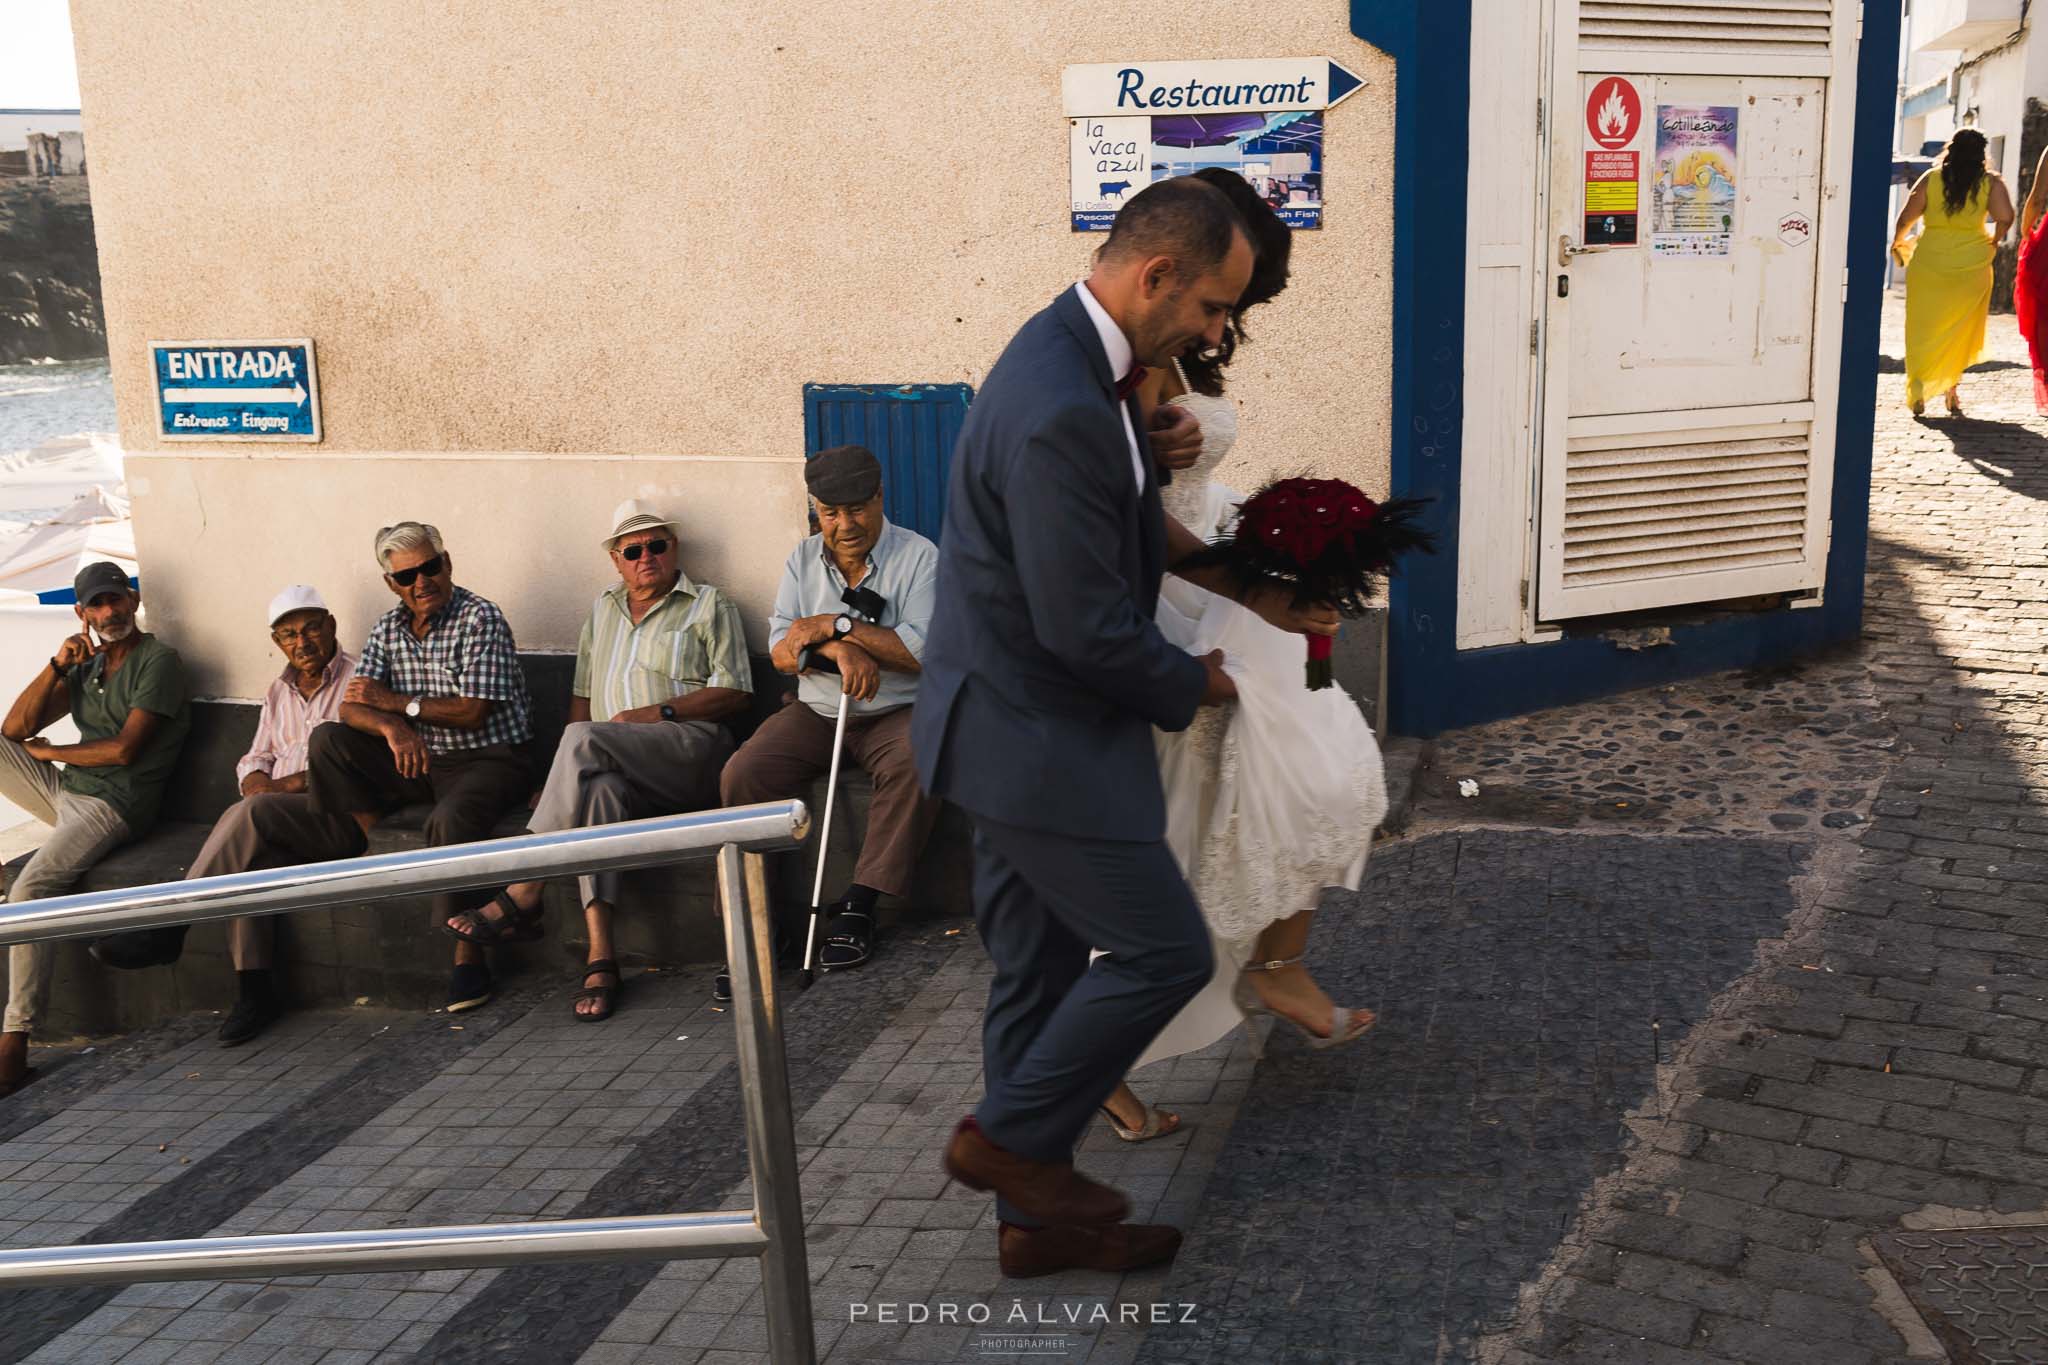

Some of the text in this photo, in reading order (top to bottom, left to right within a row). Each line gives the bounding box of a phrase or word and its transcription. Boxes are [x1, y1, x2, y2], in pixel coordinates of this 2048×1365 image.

[1117, 68, 1315, 109] Restaurant
[1086, 119, 1104, 138] la
[1088, 139, 1136, 156] vaca
[1097, 153, 1143, 173] azul
[1295, 210, 1319, 218] Fish
[168, 351, 296, 379] ENTRADA
[174, 412, 289, 432] Entrance Eingang
